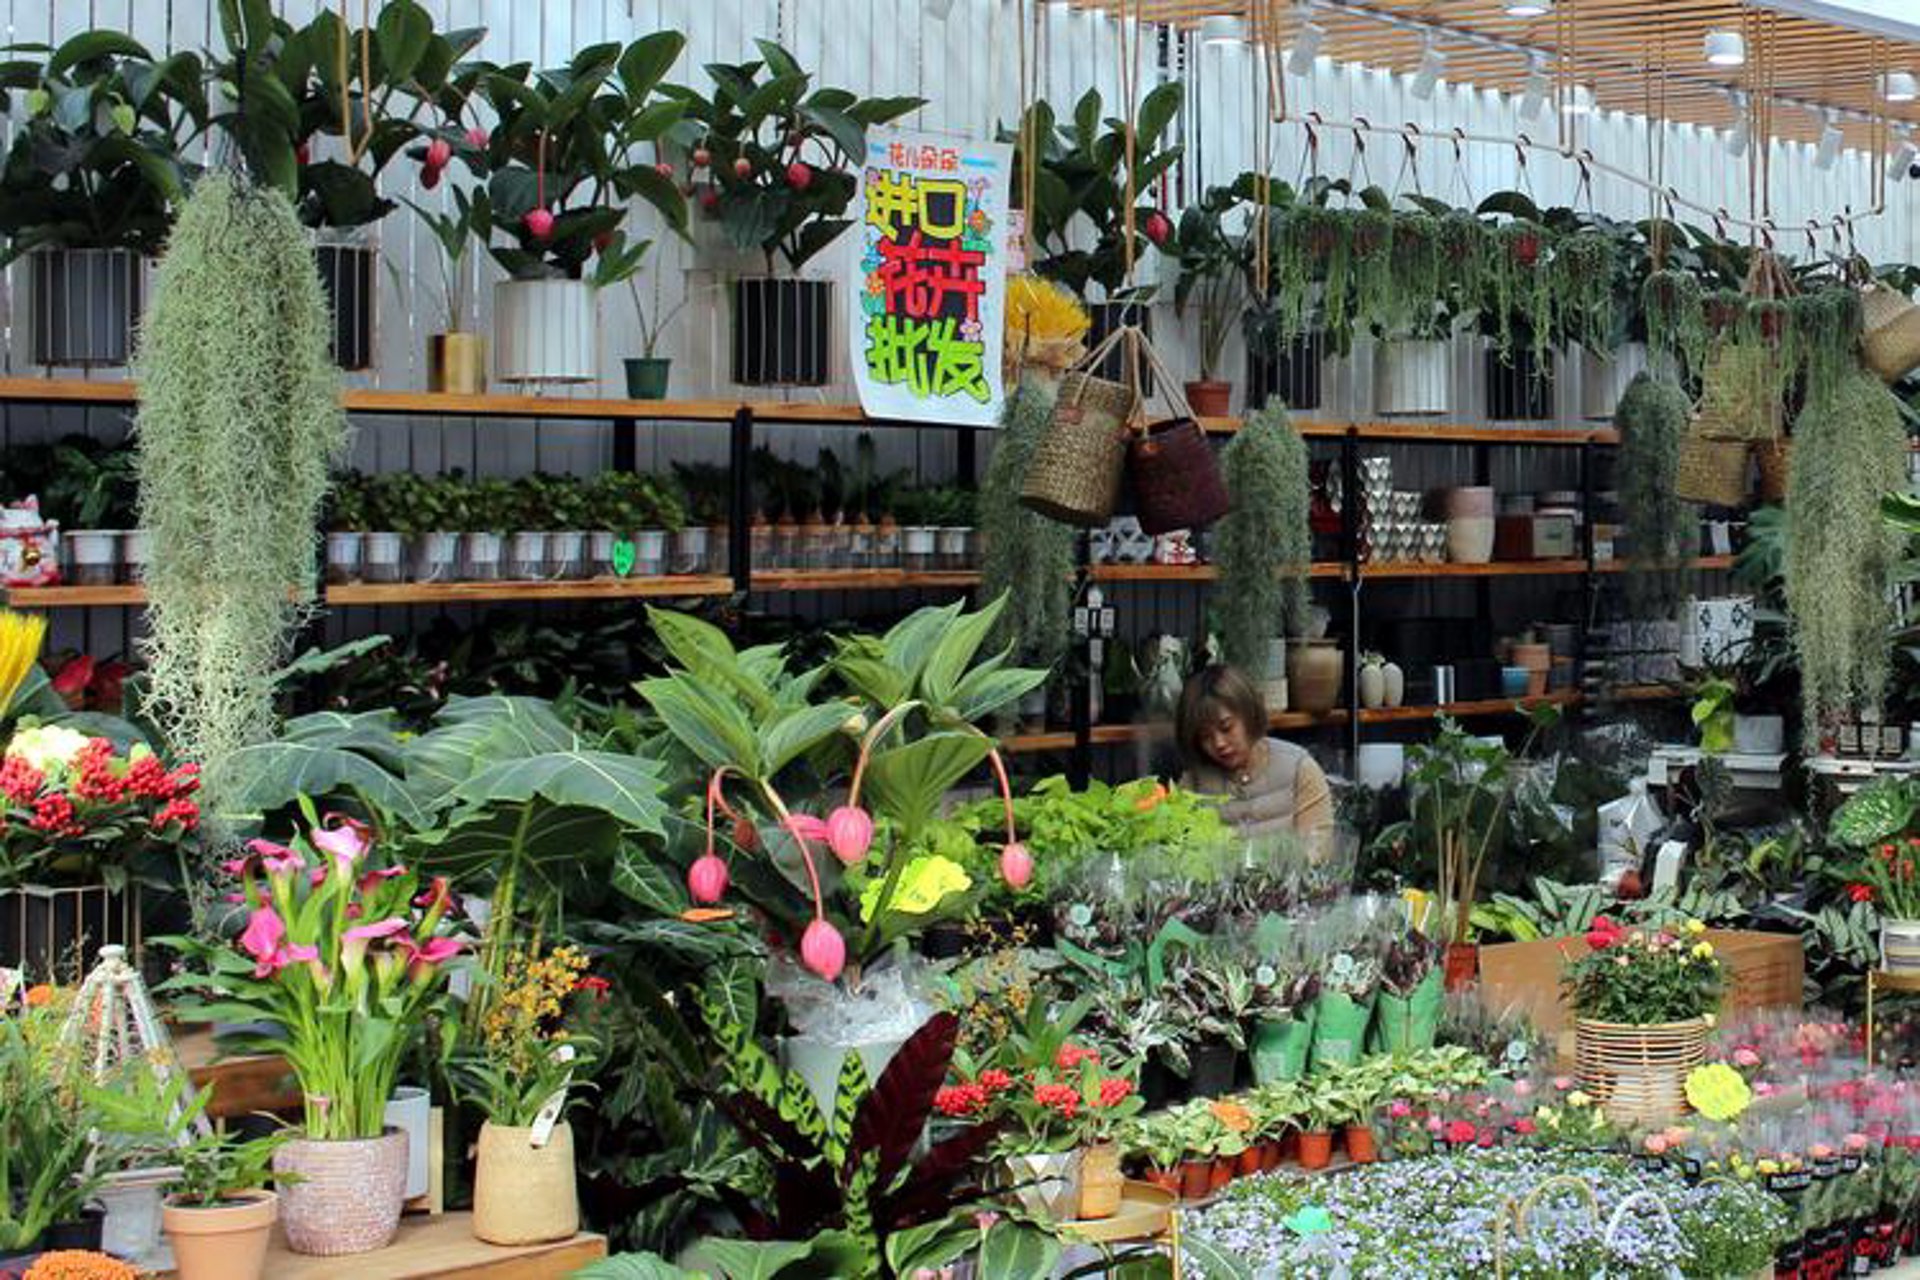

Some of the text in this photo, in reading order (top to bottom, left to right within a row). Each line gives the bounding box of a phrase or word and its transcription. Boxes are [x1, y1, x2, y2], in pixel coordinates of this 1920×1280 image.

[865, 169, 968, 241] 进口
[877, 231, 985, 320] 花卉
[866, 315, 991, 404] 批发
